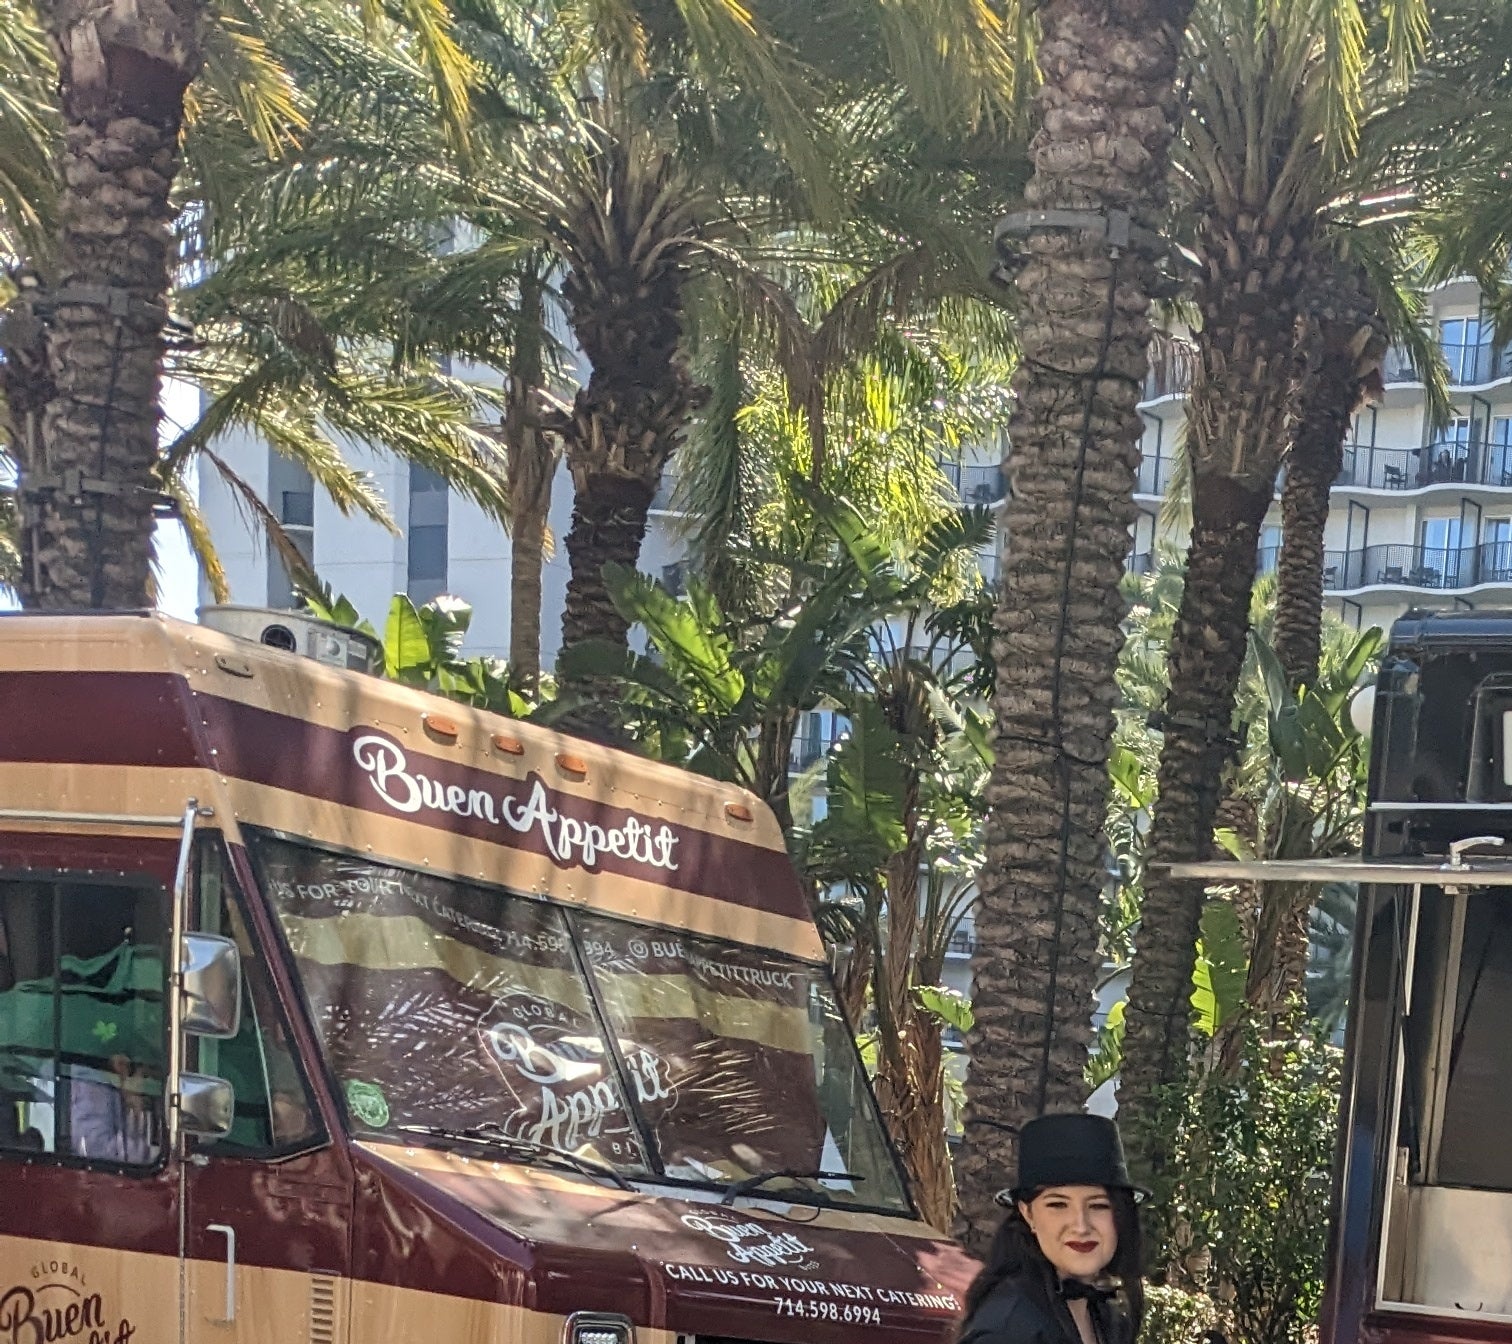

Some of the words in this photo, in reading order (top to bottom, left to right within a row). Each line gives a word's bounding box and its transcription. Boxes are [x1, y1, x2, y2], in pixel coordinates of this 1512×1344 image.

[353, 735, 499, 824] Buen
[503, 780, 679, 870] Appetit
[297, 883, 339, 899] FOR
[680, 1213, 773, 1243] Buen
[31, 1260, 87, 1287] GLOBAL
[665, 1264, 713, 1284] CALL
[716, 1268, 739, 1287] US
[741, 1272, 778, 1291] FOR
[781, 1277, 827, 1296] YOUR
[828, 1282, 874, 1301] NEXT
[774, 1297, 881, 1325] 714.598.6994
